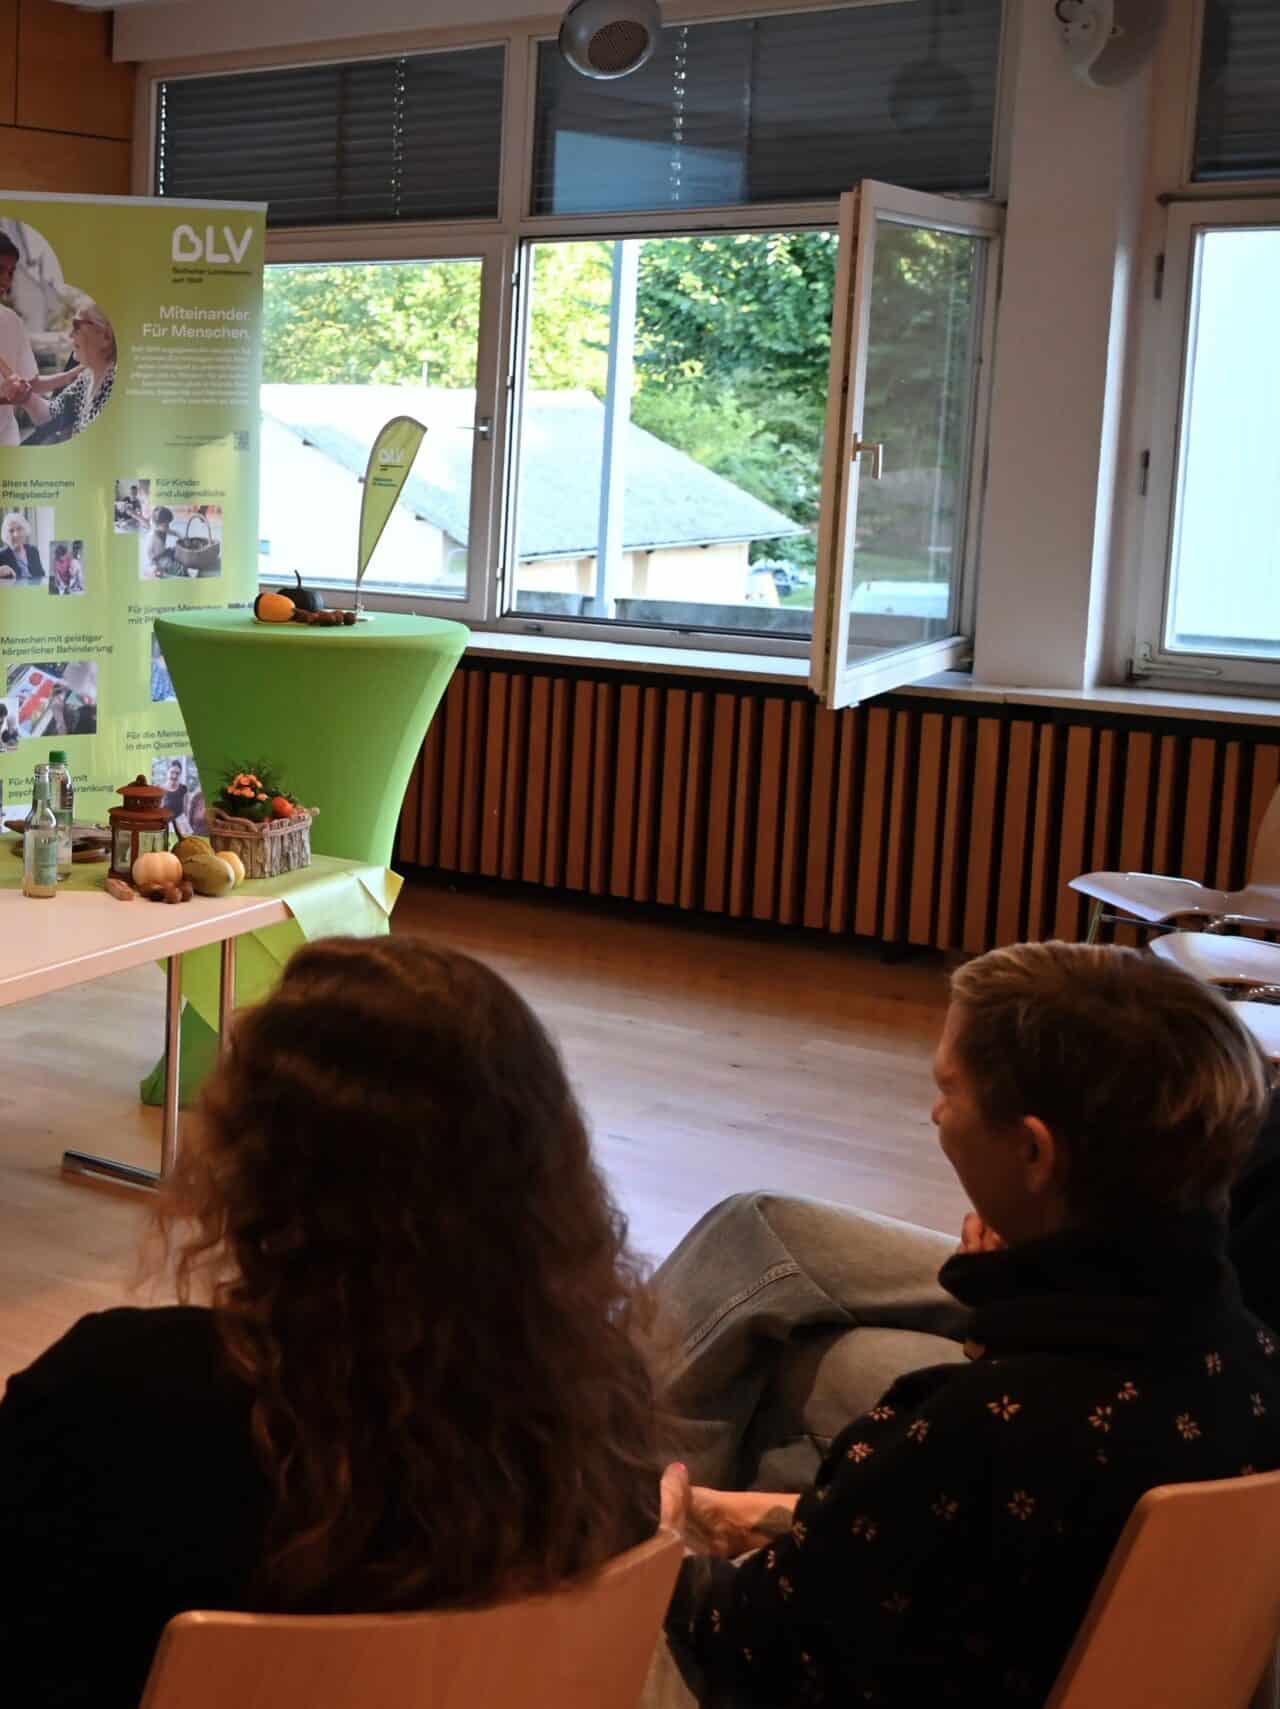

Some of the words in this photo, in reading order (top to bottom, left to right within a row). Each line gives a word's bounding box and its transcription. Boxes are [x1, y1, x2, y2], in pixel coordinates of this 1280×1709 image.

[172, 224, 254, 264] BLV
[143, 322, 169, 337] Für
[30, 479, 75, 489] Menschen
[0, 635, 46, 645] Menschen
